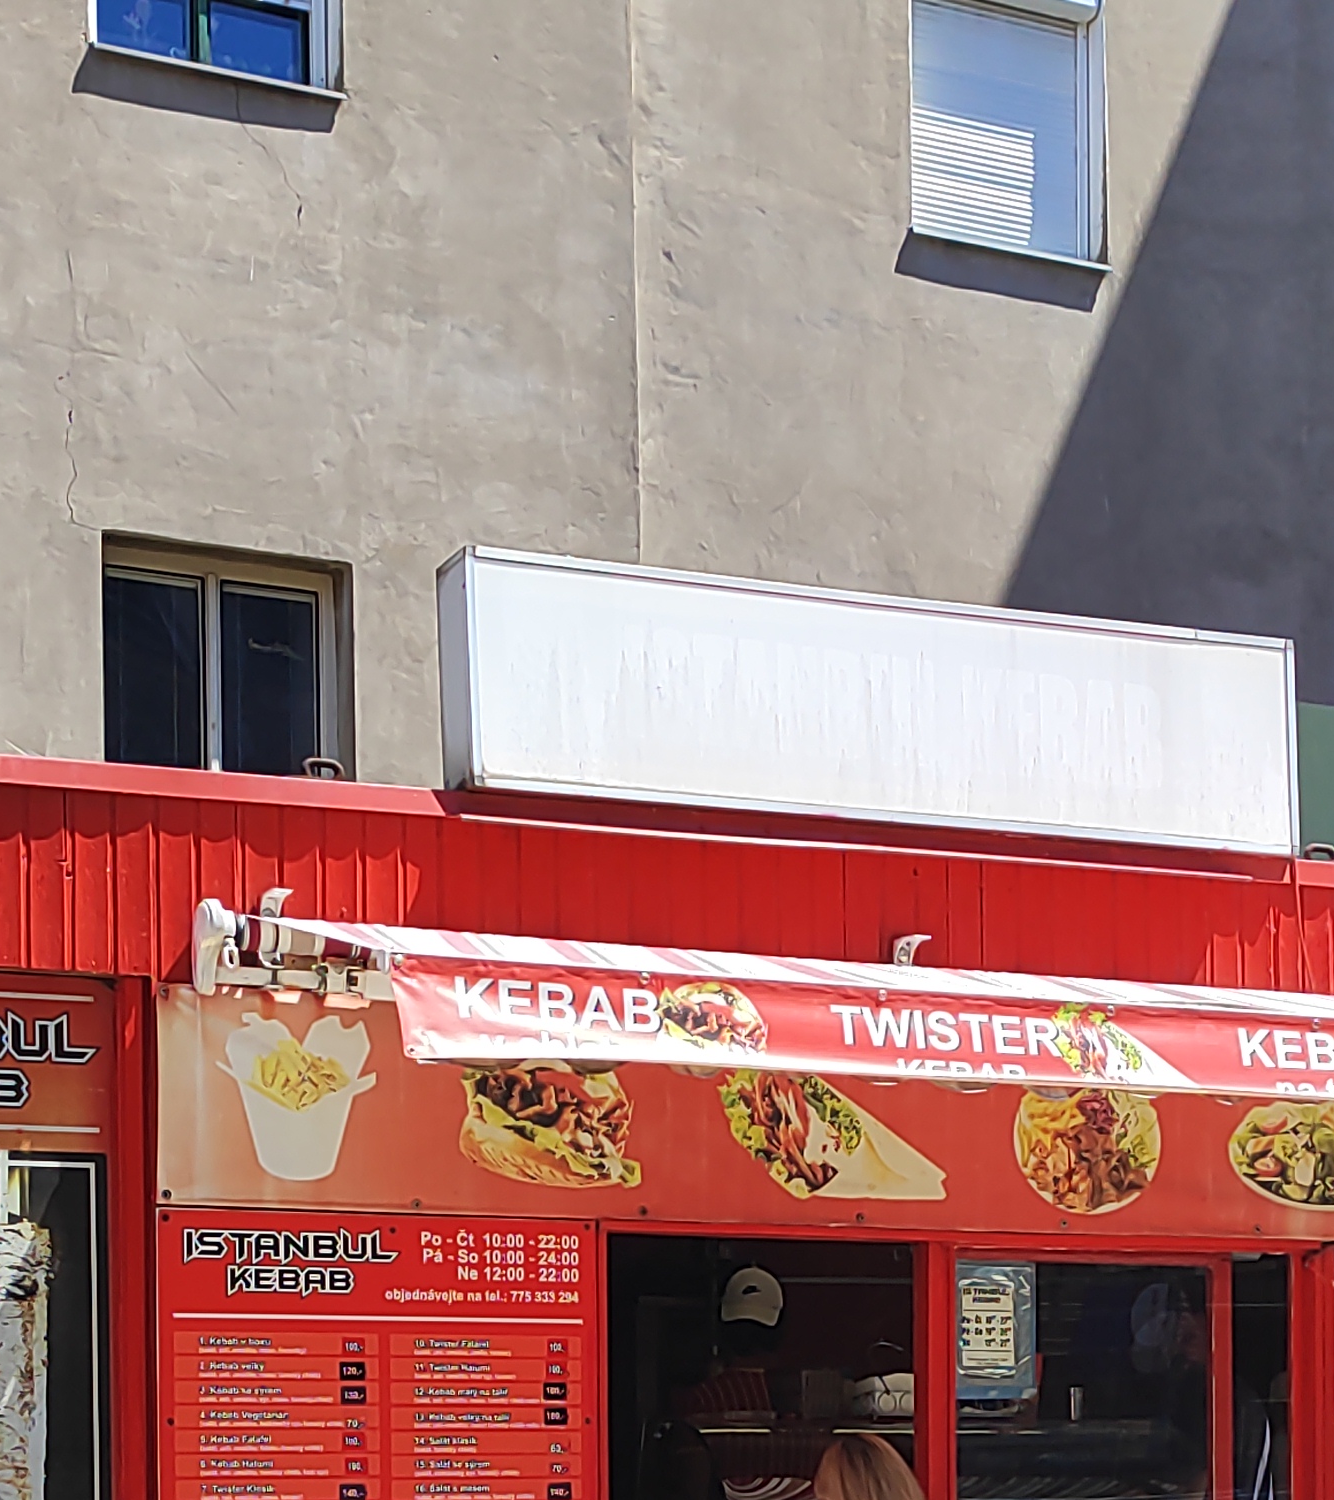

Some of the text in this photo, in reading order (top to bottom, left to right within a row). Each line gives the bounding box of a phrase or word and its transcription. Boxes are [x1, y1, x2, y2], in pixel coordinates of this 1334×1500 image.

[453, 975, 663, 1034] KEBAB
[830, 1003, 1065, 1058] TWISTER
[183, 1227, 400, 1265] ISTANBUL
[420, 1231, 443, 1246] Po
[483, 1232, 524, 1248] 10:00
[537, 1234, 579, 1249] 22:00
[423, 1247, 443, 1264] Pá
[457, 1249, 478, 1264] So
[483, 1250, 524, 1265] 10:00
[537, 1251, 579, 1266] 24:00
[226, 1264, 355, 1298] KEBAB
[457, 1266, 478, 1280] Ne
[484, 1267, 524, 1281] 12:00
[538, 1267, 579, 1282] 22:00
[467, 1292, 482, 1302] na
[510, 1290, 532, 1303] 775
